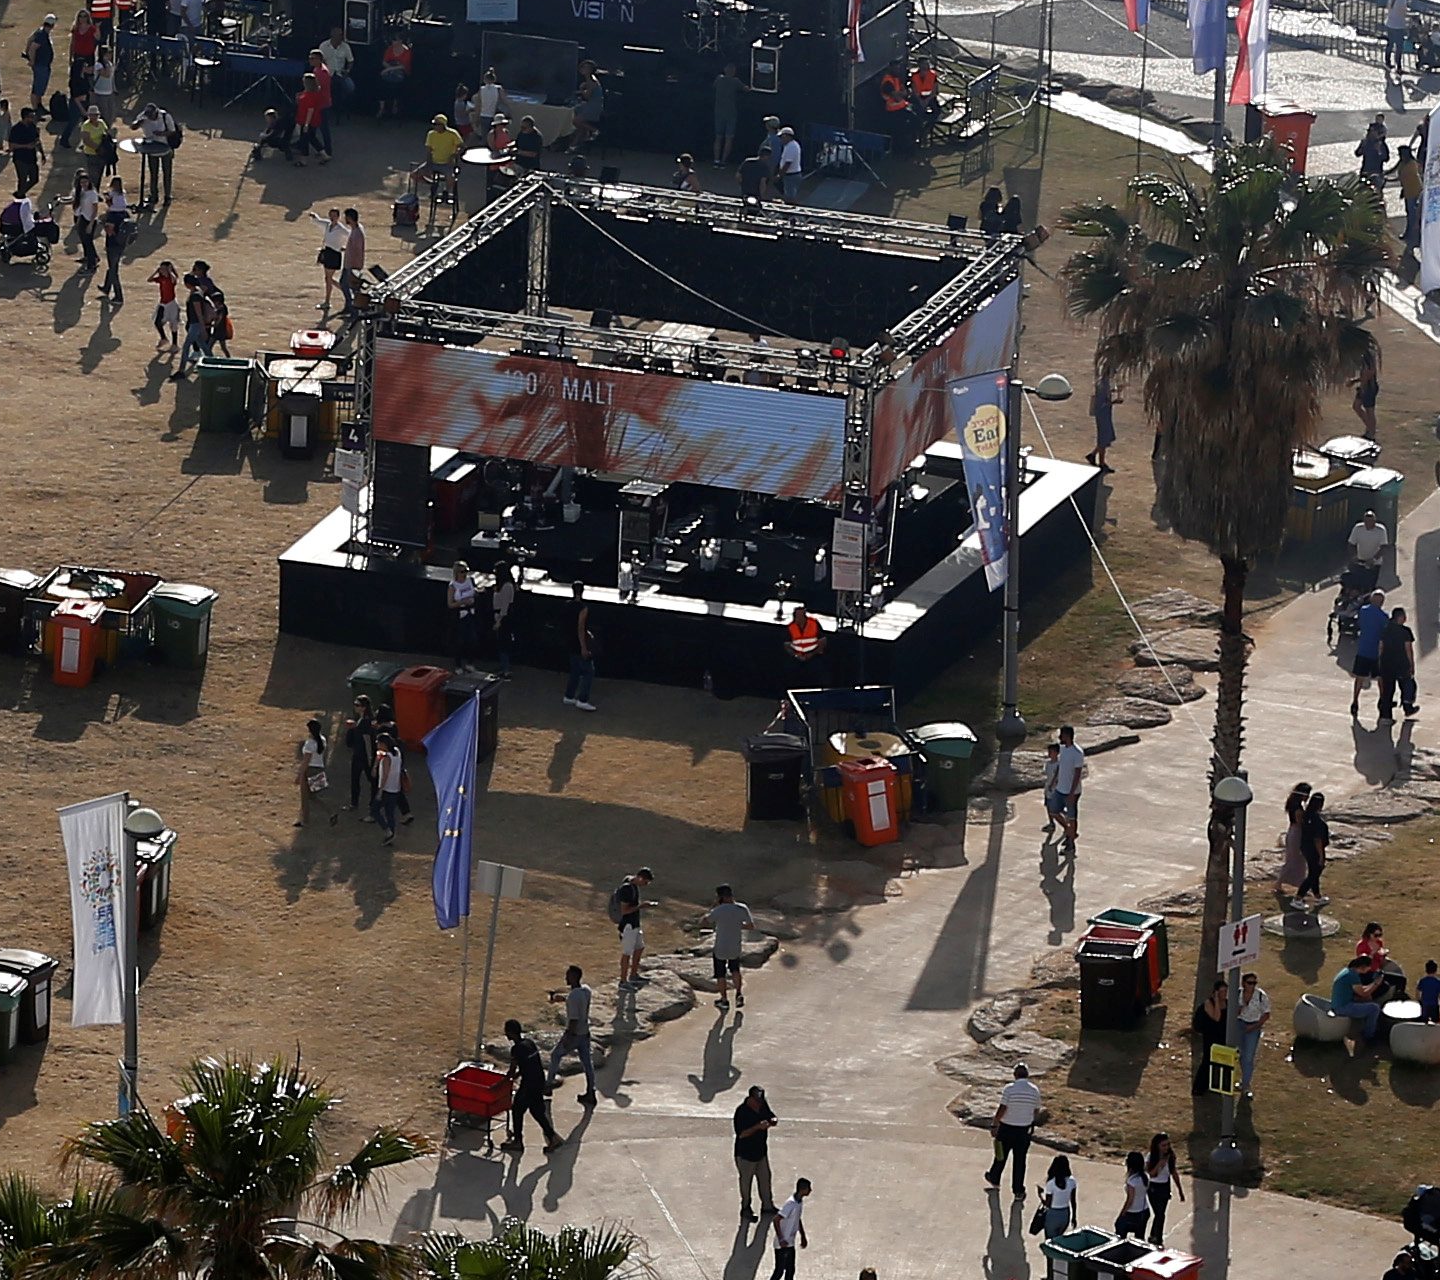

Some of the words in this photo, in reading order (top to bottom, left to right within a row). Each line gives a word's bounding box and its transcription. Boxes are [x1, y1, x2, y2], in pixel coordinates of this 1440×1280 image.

[562, 377, 616, 405] MALT
[349, 429, 359, 442] 4
[853, 501, 864, 515] 4
